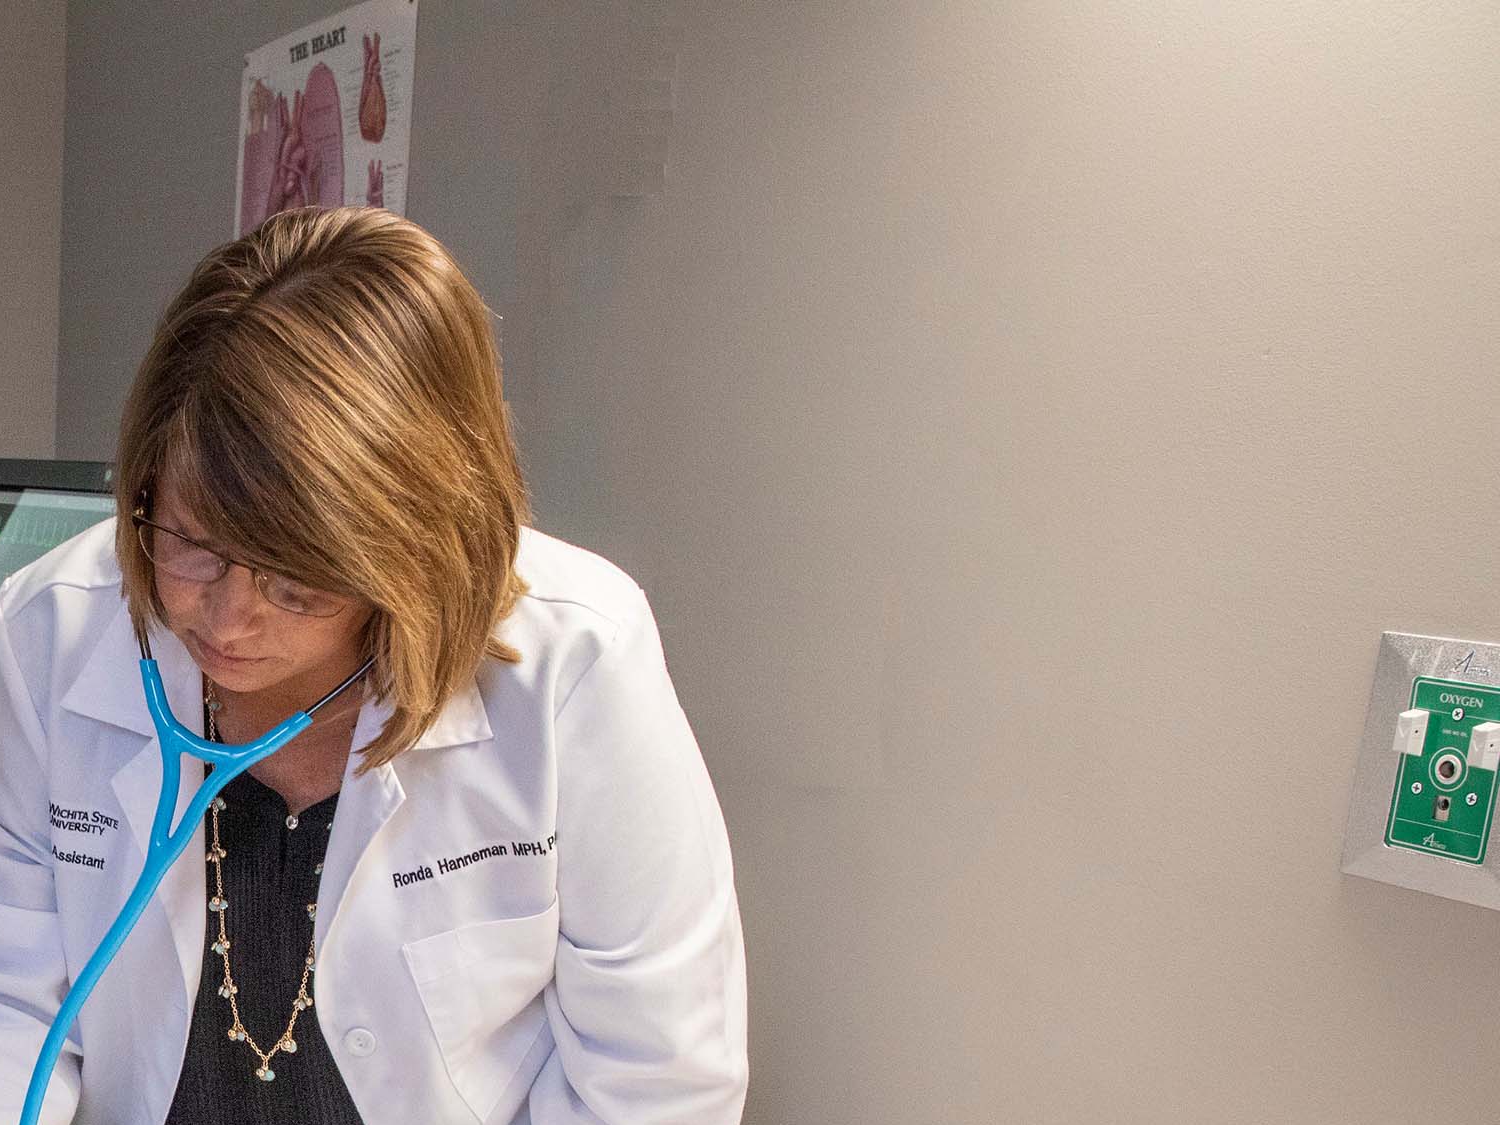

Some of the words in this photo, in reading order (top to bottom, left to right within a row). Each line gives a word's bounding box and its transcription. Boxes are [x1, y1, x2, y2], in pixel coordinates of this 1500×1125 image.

[289, 41, 309, 64] THE
[311, 26, 347, 56] HEART
[1439, 692, 1484, 709] OXYGEN
[48, 800, 89, 822] WICHITA
[91, 811, 120, 830] STATE
[51, 845, 105, 870] Assistant
[392, 865, 434, 888] Ronda
[437, 844, 508, 875] Hanneman
[511, 842, 547, 857] MPH,
